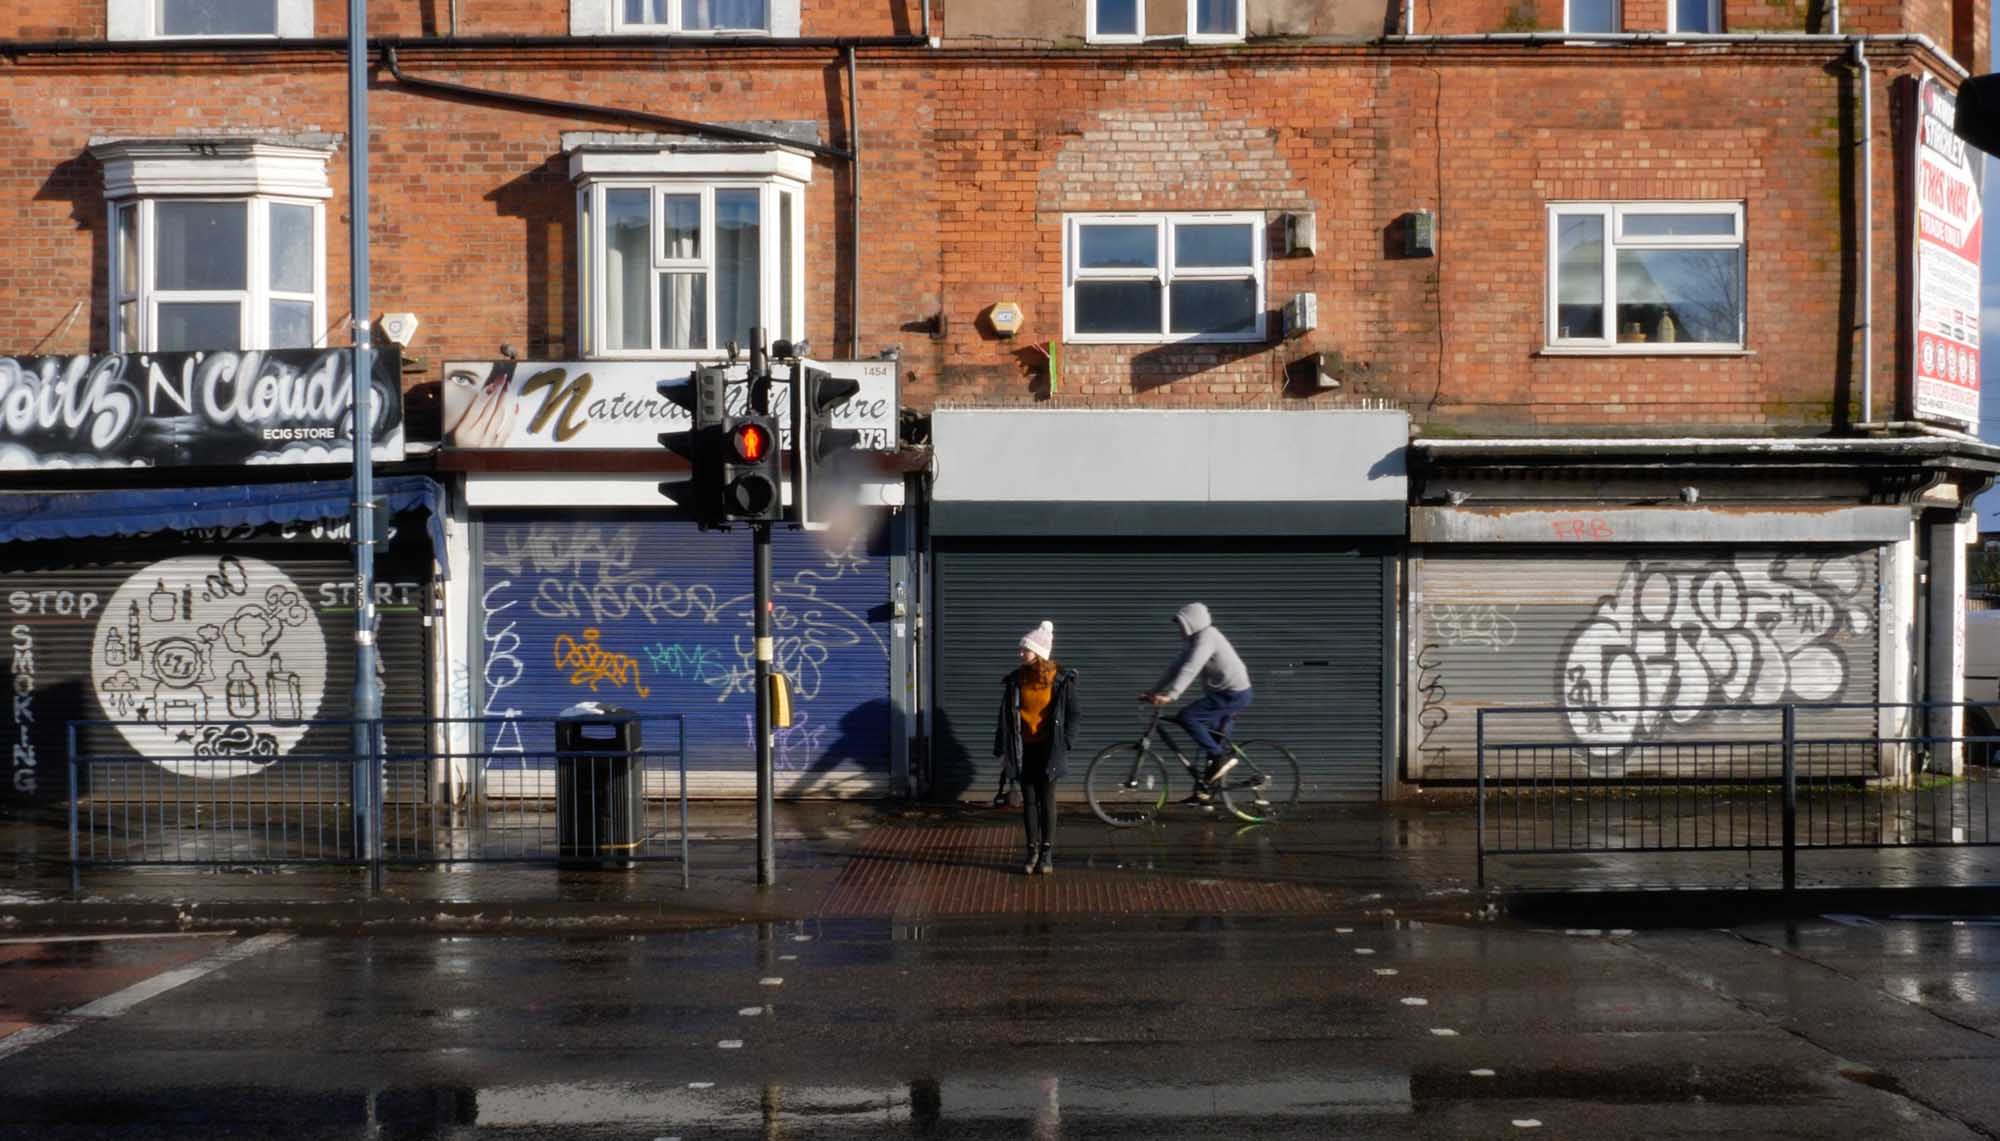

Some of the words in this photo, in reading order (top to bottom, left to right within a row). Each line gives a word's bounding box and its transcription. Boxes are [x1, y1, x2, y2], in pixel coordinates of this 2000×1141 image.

[1920, 159, 1944, 210] THIS
[1945, 174, 1970, 222] WAY
[864, 367, 888, 376] 1454
[828, 396, 888, 420] are
[263, 428, 292, 440] ECIG
[294, 427, 335, 439] STORE
[8, 590, 100, 619] STOP
[318, 582, 420, 606] STRT
[10, 623, 38, 796] SMOKING
